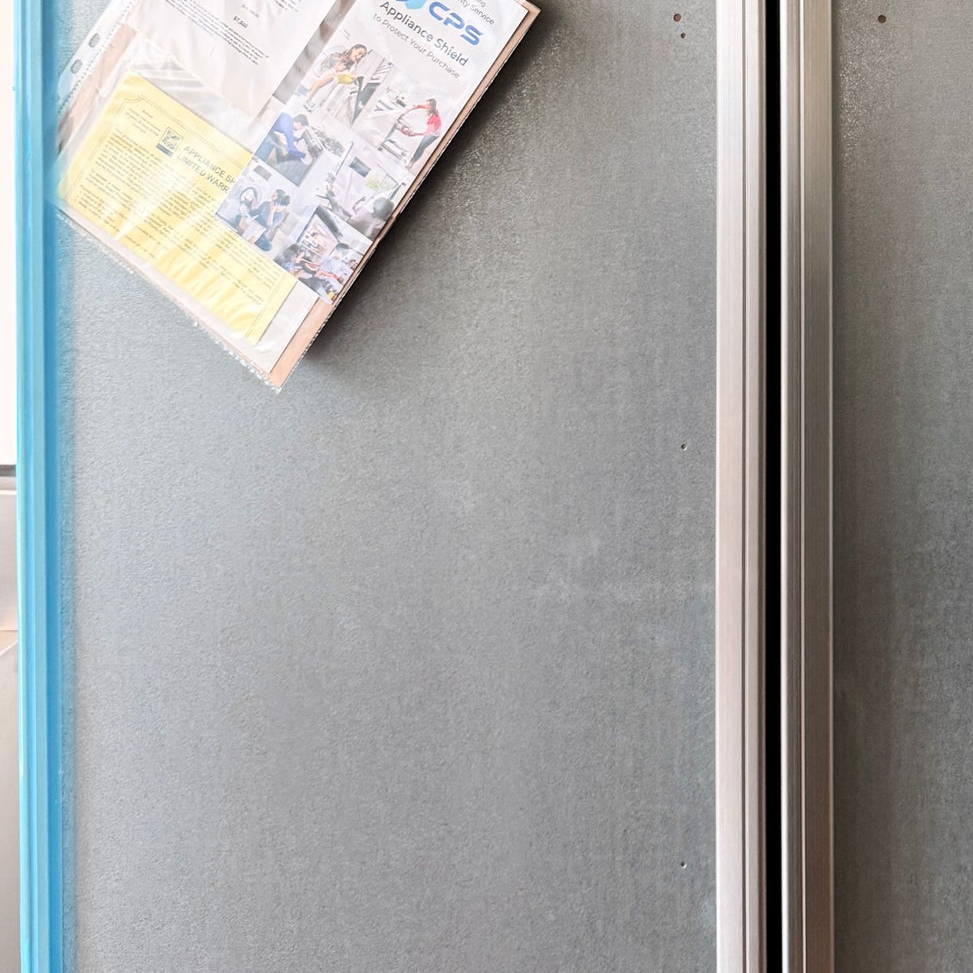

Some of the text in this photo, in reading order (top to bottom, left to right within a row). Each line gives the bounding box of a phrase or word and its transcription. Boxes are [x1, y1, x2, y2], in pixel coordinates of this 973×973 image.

[469, 4, 497, 26] Service
[372, 13, 462, 80] to Protect Your Purchase
[378, 0, 470, 67] Appliance Shield
[176, 152, 208, 178] LIMITED
[183, 144, 227, 179] APPLIANCE
